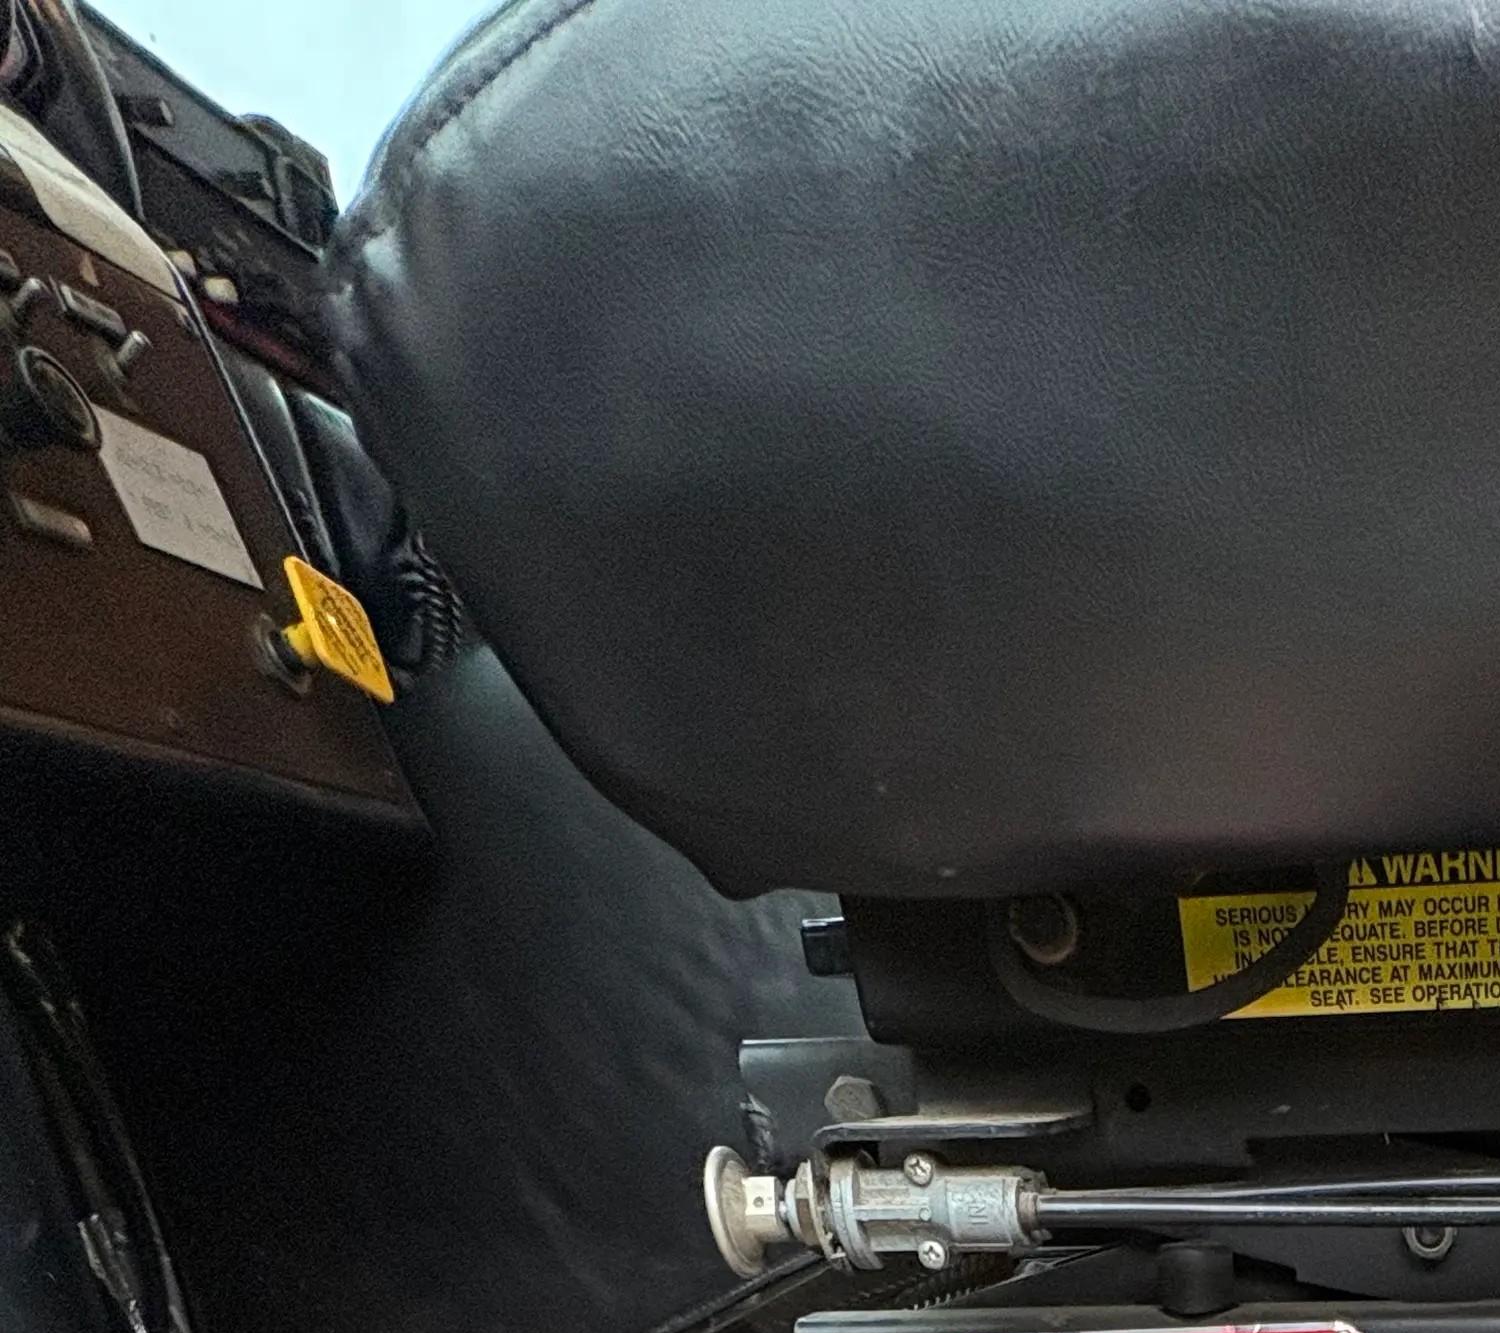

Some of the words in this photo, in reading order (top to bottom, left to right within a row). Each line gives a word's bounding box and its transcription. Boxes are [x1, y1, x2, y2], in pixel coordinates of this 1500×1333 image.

[1216, 906, 1297, 926] SERIOUS
[1379, 899, 1415, 918] MAY
[1424, 895, 1489, 915] OCCUR
[1233, 930, 1249, 946] IS
[1415, 918, 1488, 938] BEFORE
[1351, 944, 1426, 963] ENSURE
[1434, 941, 1478, 959] THAT
[1391, 965, 1410, 982] AT
[1311, 990, 1360, 1007] SEAT.
[1370, 987, 1404, 1004] SEE
